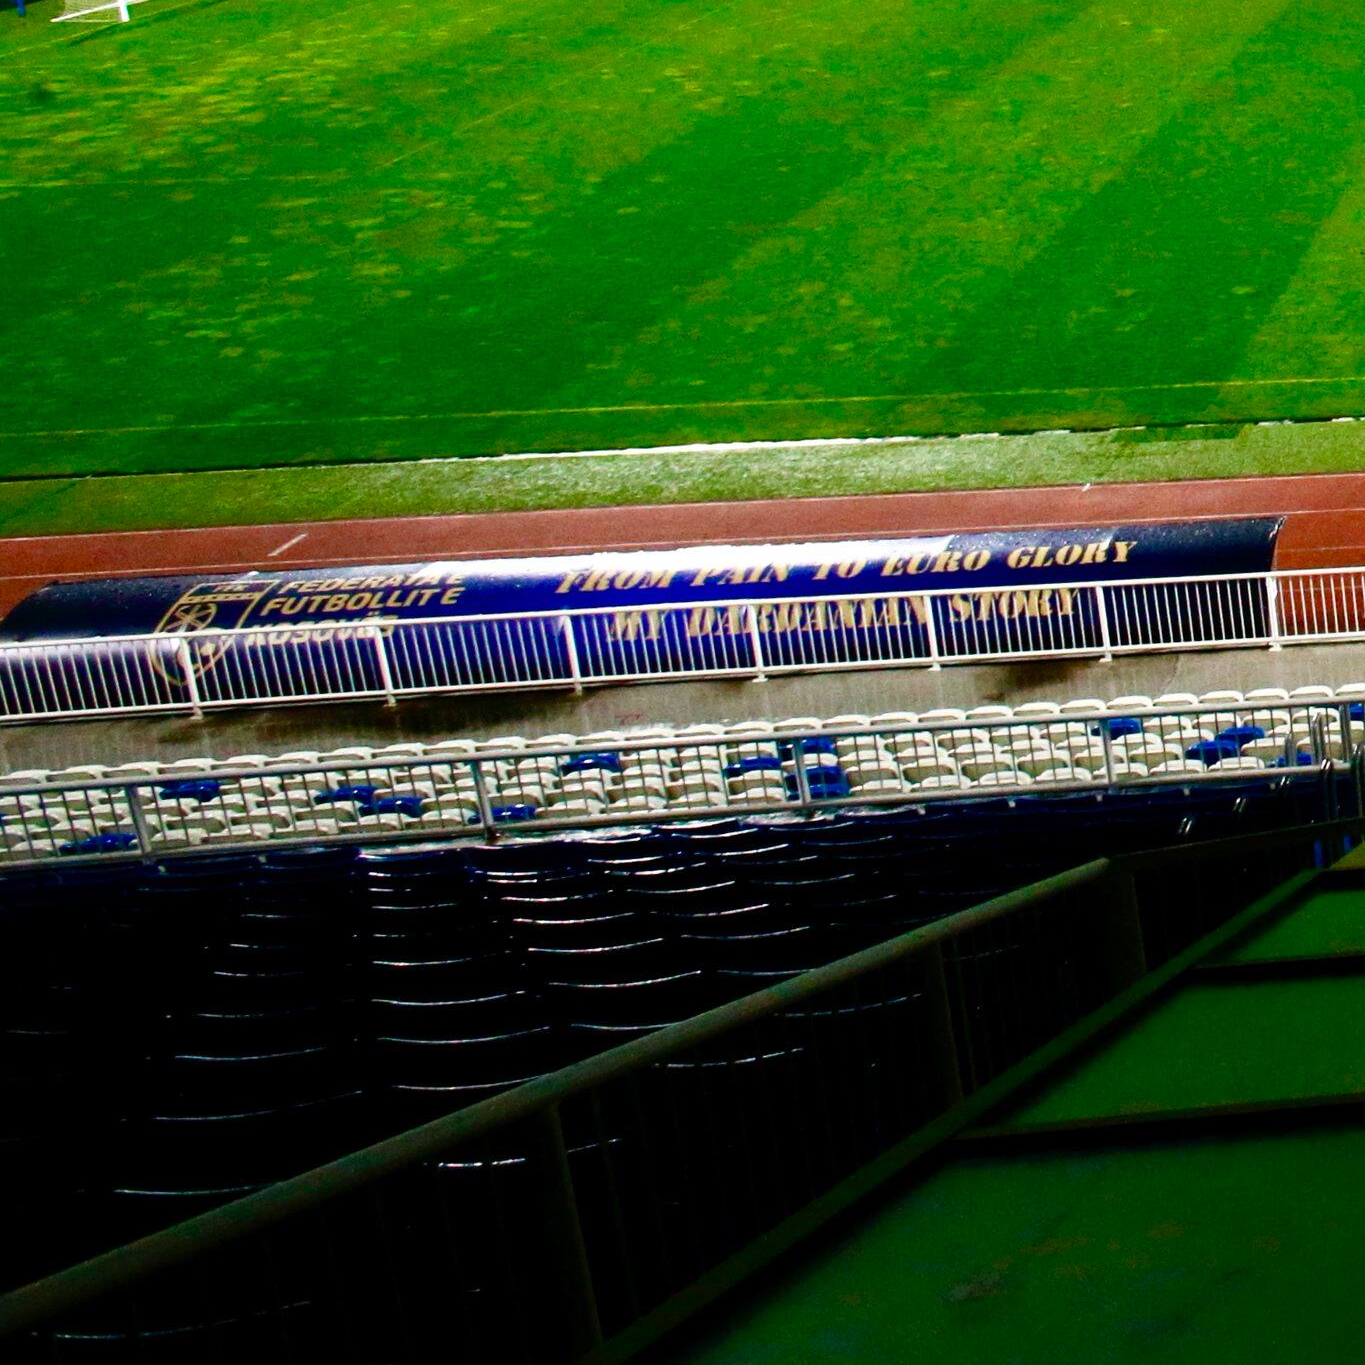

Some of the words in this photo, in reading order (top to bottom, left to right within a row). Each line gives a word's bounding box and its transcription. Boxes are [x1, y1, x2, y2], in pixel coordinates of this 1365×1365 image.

[555, 569, 678, 593] FROM
[690, 563, 790, 587] PAIN
[812, 559, 868, 581] TO
[880, 549, 992, 576] EURO
[1007, 541, 1137, 569] GLORY
[277, 574, 441, 595] FEDERATA
[445, 573, 466, 585] E
[260, 589, 441, 616] FUTBOLLIT
[440, 587, 466, 605] E
[950, 588, 1078, 622] STORY
